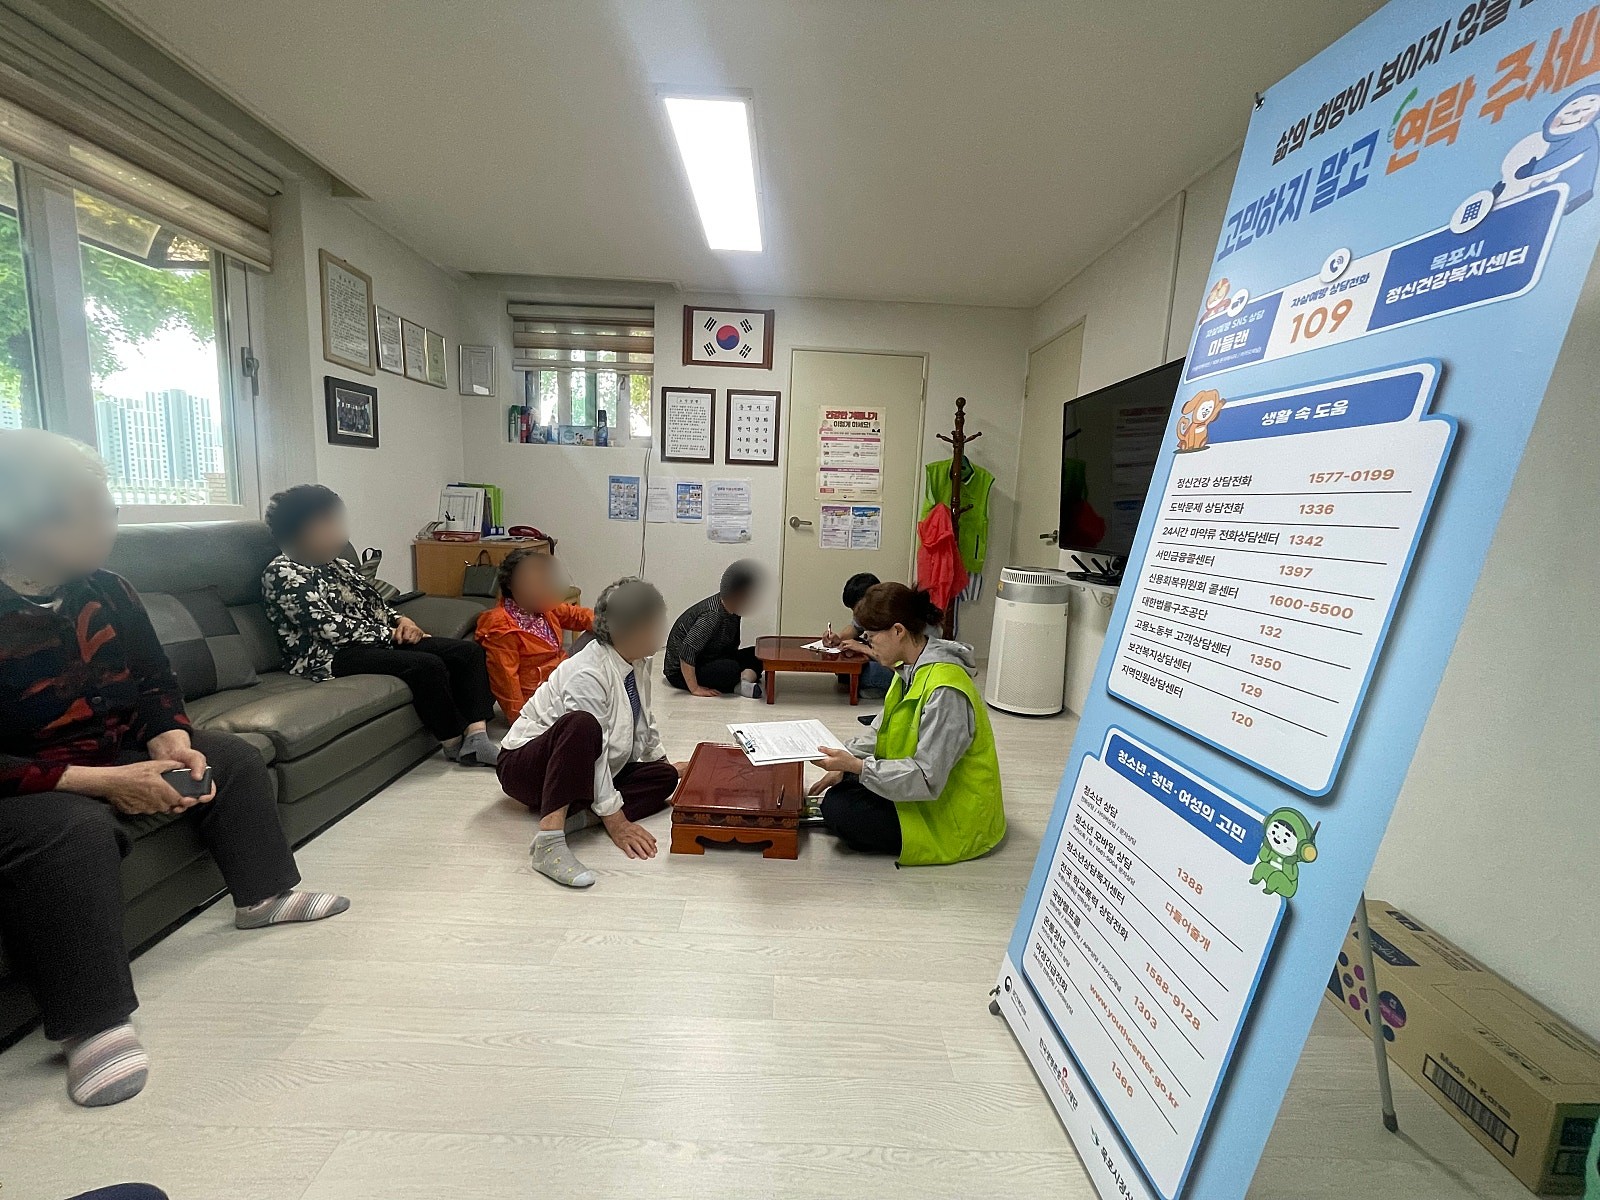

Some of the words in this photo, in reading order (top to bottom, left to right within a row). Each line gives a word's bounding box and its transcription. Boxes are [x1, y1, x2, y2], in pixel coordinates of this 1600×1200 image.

[1272, 115, 1307, 166] 삶의
[1308, 71, 1372, 140] 희망이
[1371, 19, 1451, 102] 보이지
[1449, 0, 1511, 54] 않을
[1217, 168, 1311, 262] 고민하지
[1310, 129, 1380, 213] 말고
[1385, 74, 1476, 176] 연락
[1385, 245, 1529, 305] 정신건강복지센터
[1430, 239, 1485, 271] 목포시
[1290, 288, 1329, 308] 자살예방
[1329, 272, 1370, 296] 상담전화
[1231, 315, 1248, 328] SNS
[1248, 309, 1265, 323] 상담
[1290, 298, 1353, 344] 109
[1207, 328, 1250, 357] 마들랜
[1261, 408, 1292, 427] 생활
[1294, 406, 1310, 421] 속
[1312, 399, 1349, 419] 도움
[1176, 476, 1210, 489] 정신건강
[1212, 474, 1253, 488] 상담전화
[1308, 468, 1395, 484] 1577-0199
[1169, 502, 1202, 514] 도박문제
[1204, 502, 1244, 515] 상담전화
[1299, 503, 1335, 516] 1336
[1162, 526, 1189, 538] 24시간
[1190, 528, 1217, 541] 마약류
[1218, 529, 1280, 546] 전화상담센터
[1288, 534, 1325, 548] 1342
[1155, 549, 1215, 567] 서민금융콜센터
[1278, 564, 1314, 579] 1397
[1141, 596, 1209, 621] 대한법률구조공단
[1258, 624, 1284, 640] 132
[1148, 573, 1208, 594] 신용회복위원회
[1208, 583, 1239, 599] 콜센터
[1269, 594, 1354, 620] 1600-5500
[1134, 619, 1174, 639] 고용노동부
[1175, 631, 1232, 658] 고객상담센터
[1249, 653, 1282, 672] 1350
[1127, 641, 1192, 674] 보건복지상담센터
[1240, 682, 1264, 699] 129
[1121, 664, 1184, 700] 지역민원상담센터
[1230, 711, 1254, 728] 120
[1083, 785, 1103, 807] 청소년
[1103, 801, 1119, 819] 상담
[1176, 867, 1204, 895] 1388
[1215, 814, 1247, 844] 고민
[1066, 840, 1125, 905] 청소년상담복지센터
[1075, 813, 1094, 836] 청소년
[1094, 830, 1116, 856] 모바일
[1116, 851, 1132, 871] 상담
[1165, 901, 1211, 952] 다들어줄개
[1060, 861, 1072, 880] 전국
[1073, 874, 1099, 908] 학교폭력
[1099, 905, 1129, 942] 상담전화
[1144, 961, 1201, 1031] 1588-9128
[1035, 942, 1068, 994] 여성긴급전화
[1111, 1060, 1134, 1098] 1366
[1133, 995, 1158, 1031] 1303
[1089, 983, 1180, 1109] www.youthcenter.go.kr
[1440, 1052, 1466, 1080] Made
[1480, 1088, 1512, 1120] Korea
